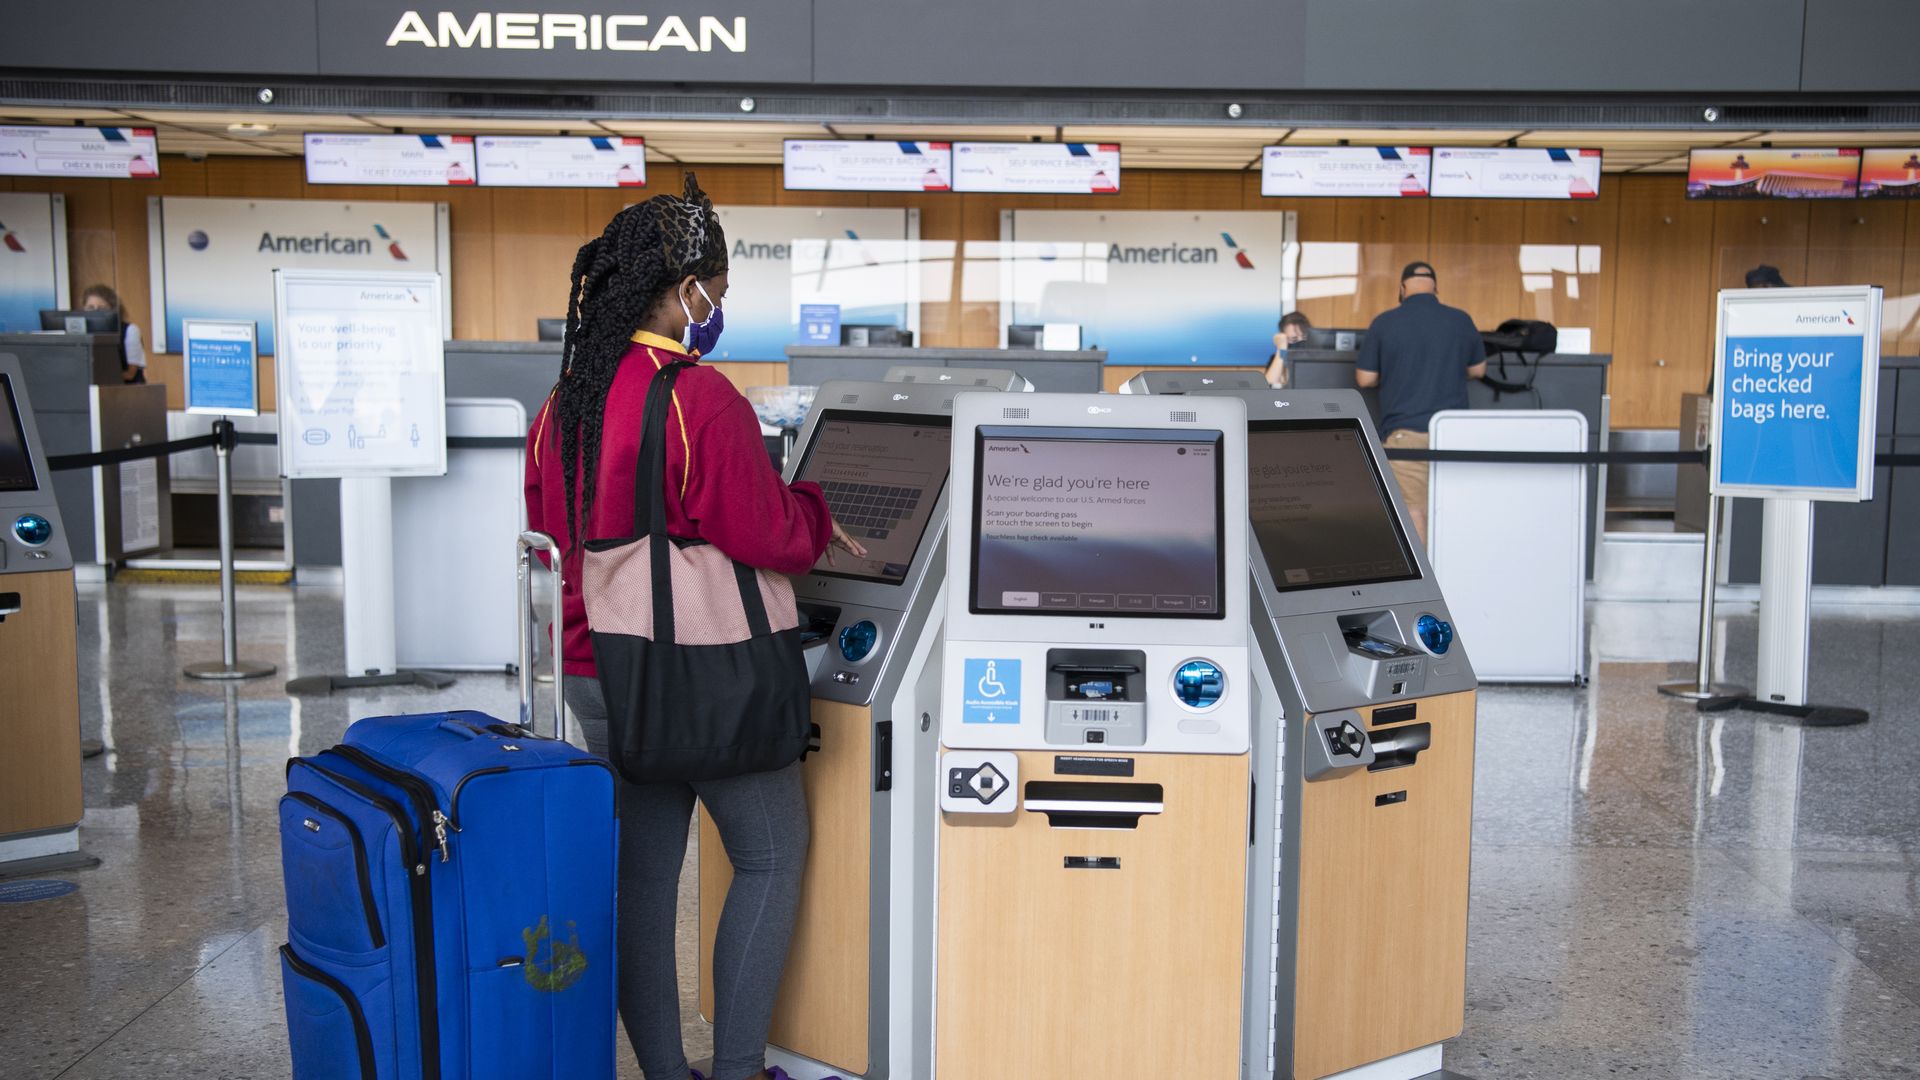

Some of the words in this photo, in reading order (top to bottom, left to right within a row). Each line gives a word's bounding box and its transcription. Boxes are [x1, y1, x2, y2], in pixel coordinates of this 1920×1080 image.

[386, 11, 746, 52] AMERICAN
[81, 142, 105, 152] MAIN
[258, 232, 371, 254] American
[1108, 243, 1218, 263] American
[360, 291, 406, 300] American
[1795, 314, 1841, 324] American
[298, 322, 327, 334] Your
[331, 323, 396, 337] well-being
[311, 341, 332, 350] our
[336, 340, 383, 352] priority
[1733, 348, 1783, 374] Bring
[1786, 351, 1834, 373] your
[1732, 374, 1812, 394] checked
[1731, 399, 1775, 424] bags
[1781, 399, 1830, 420] here.
[987, 474, 1029, 488] We're
[1033, 475, 1063, 491] glad
[1067, 476, 1112, 492] you're
[1116, 477, 1150, 490] here
[1081, 496, 1095, 504] U.S.
[1096, 496, 1122, 504] Armed
[1123, 496, 1146, 504] forces
[986, 509, 1005, 517] Scan
[1005, 511, 1024, 519] your
[1025, 510, 1060, 519] boarding
[1071, 521, 1093, 529] begin
